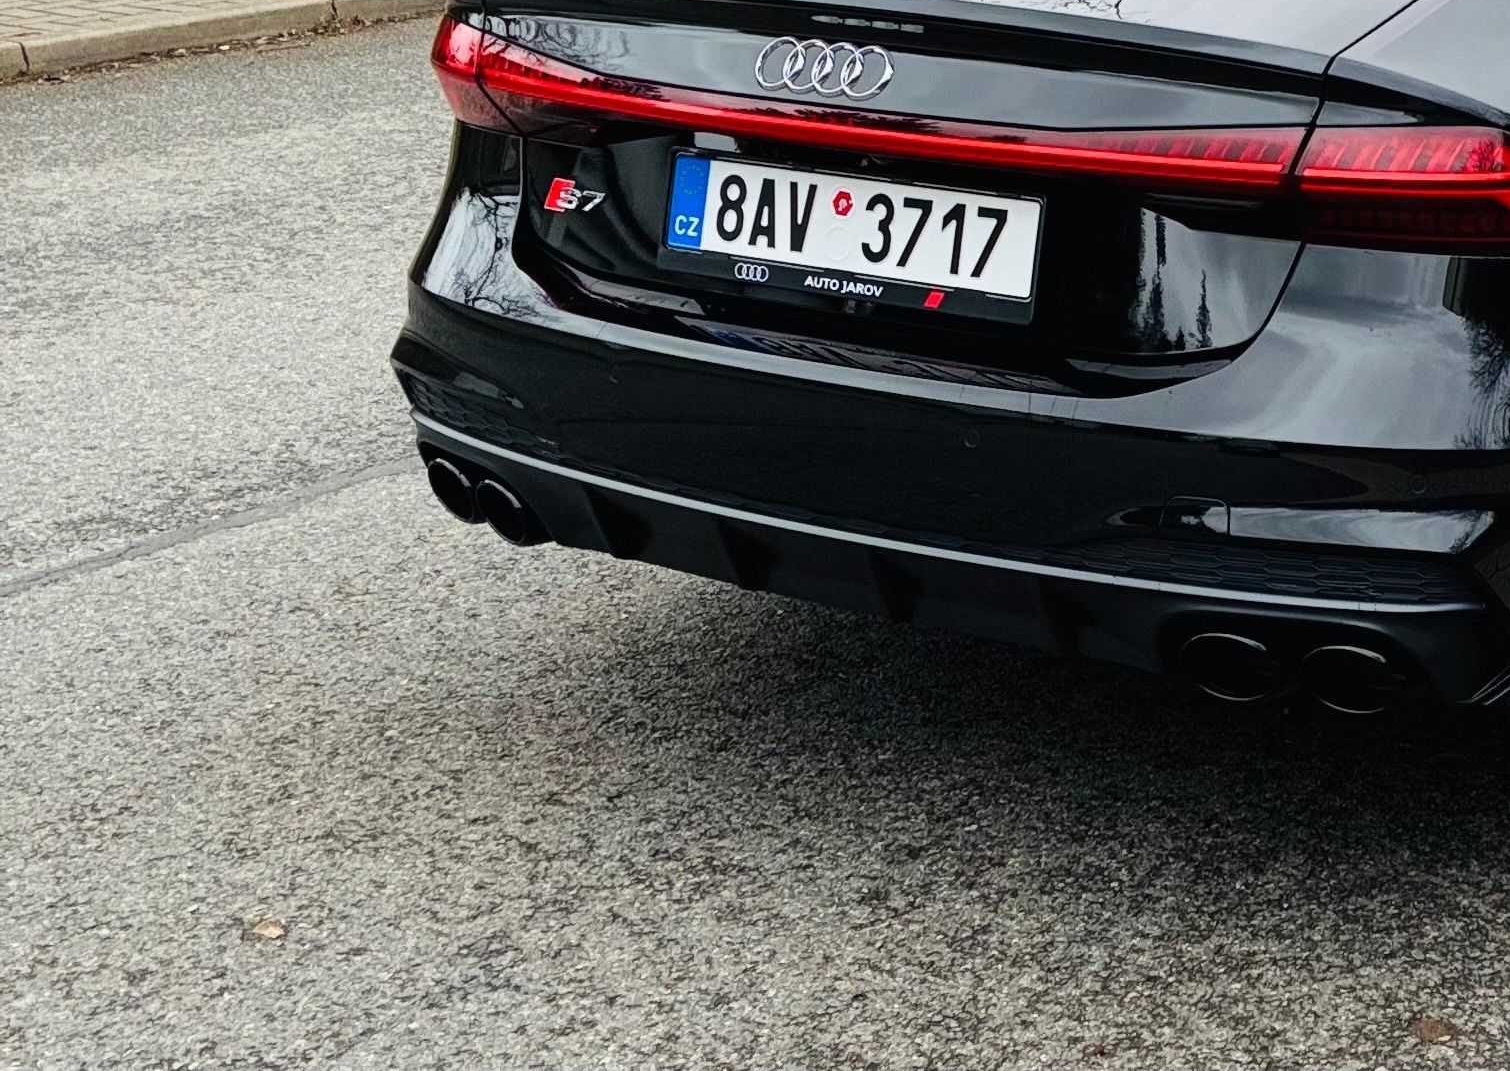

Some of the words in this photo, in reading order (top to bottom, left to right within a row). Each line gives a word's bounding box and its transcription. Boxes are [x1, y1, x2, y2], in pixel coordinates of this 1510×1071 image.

[556, 186, 606, 212] S7
[673, 214, 700, 237] CZ
[716, 174, 818, 253] 8AV
[861, 192, 1009, 278] 3717
[803, 275, 840, 291] AUTO
[840, 280, 884, 297] JAROV
